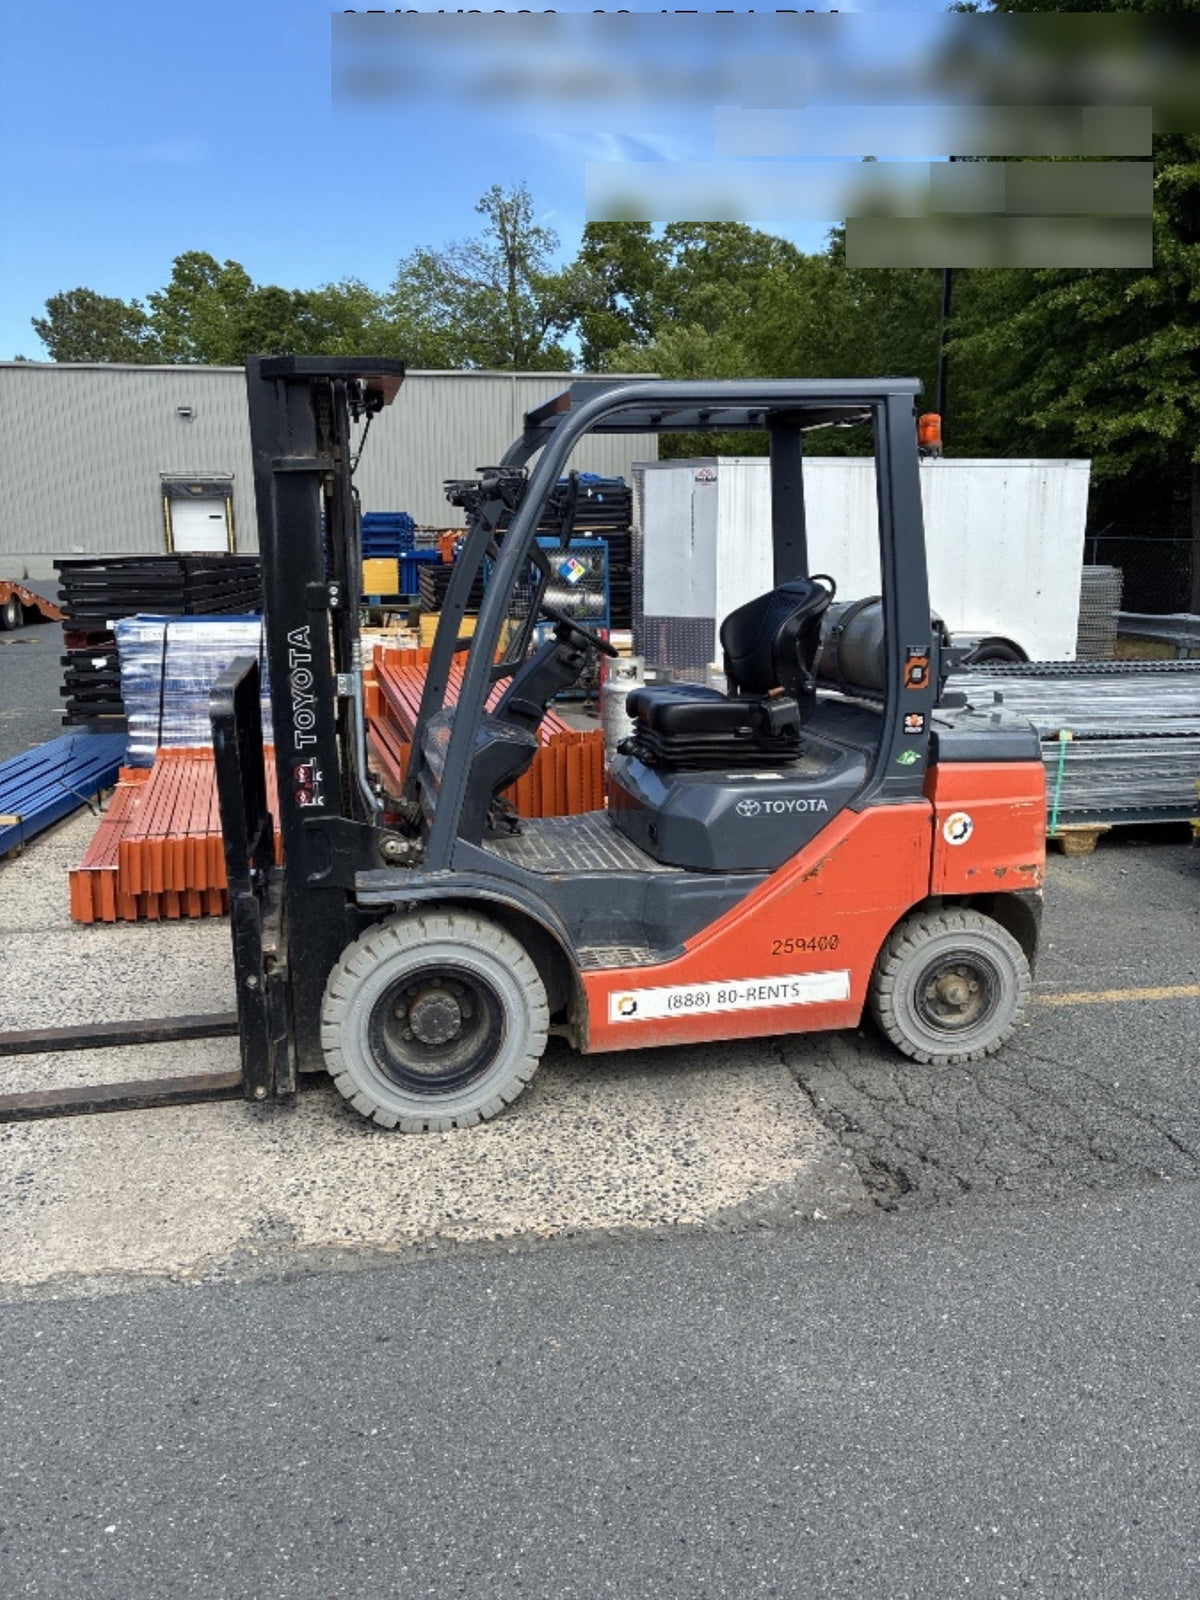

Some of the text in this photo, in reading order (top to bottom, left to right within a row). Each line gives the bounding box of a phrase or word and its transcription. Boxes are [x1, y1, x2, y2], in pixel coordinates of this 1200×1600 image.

[288, 625, 317, 749] TOYOTA
[762, 799, 828, 813] TOYOTA
[771, 934, 839, 955] 259400
[667, 982, 800, 1010] (888) 80-RENTS
